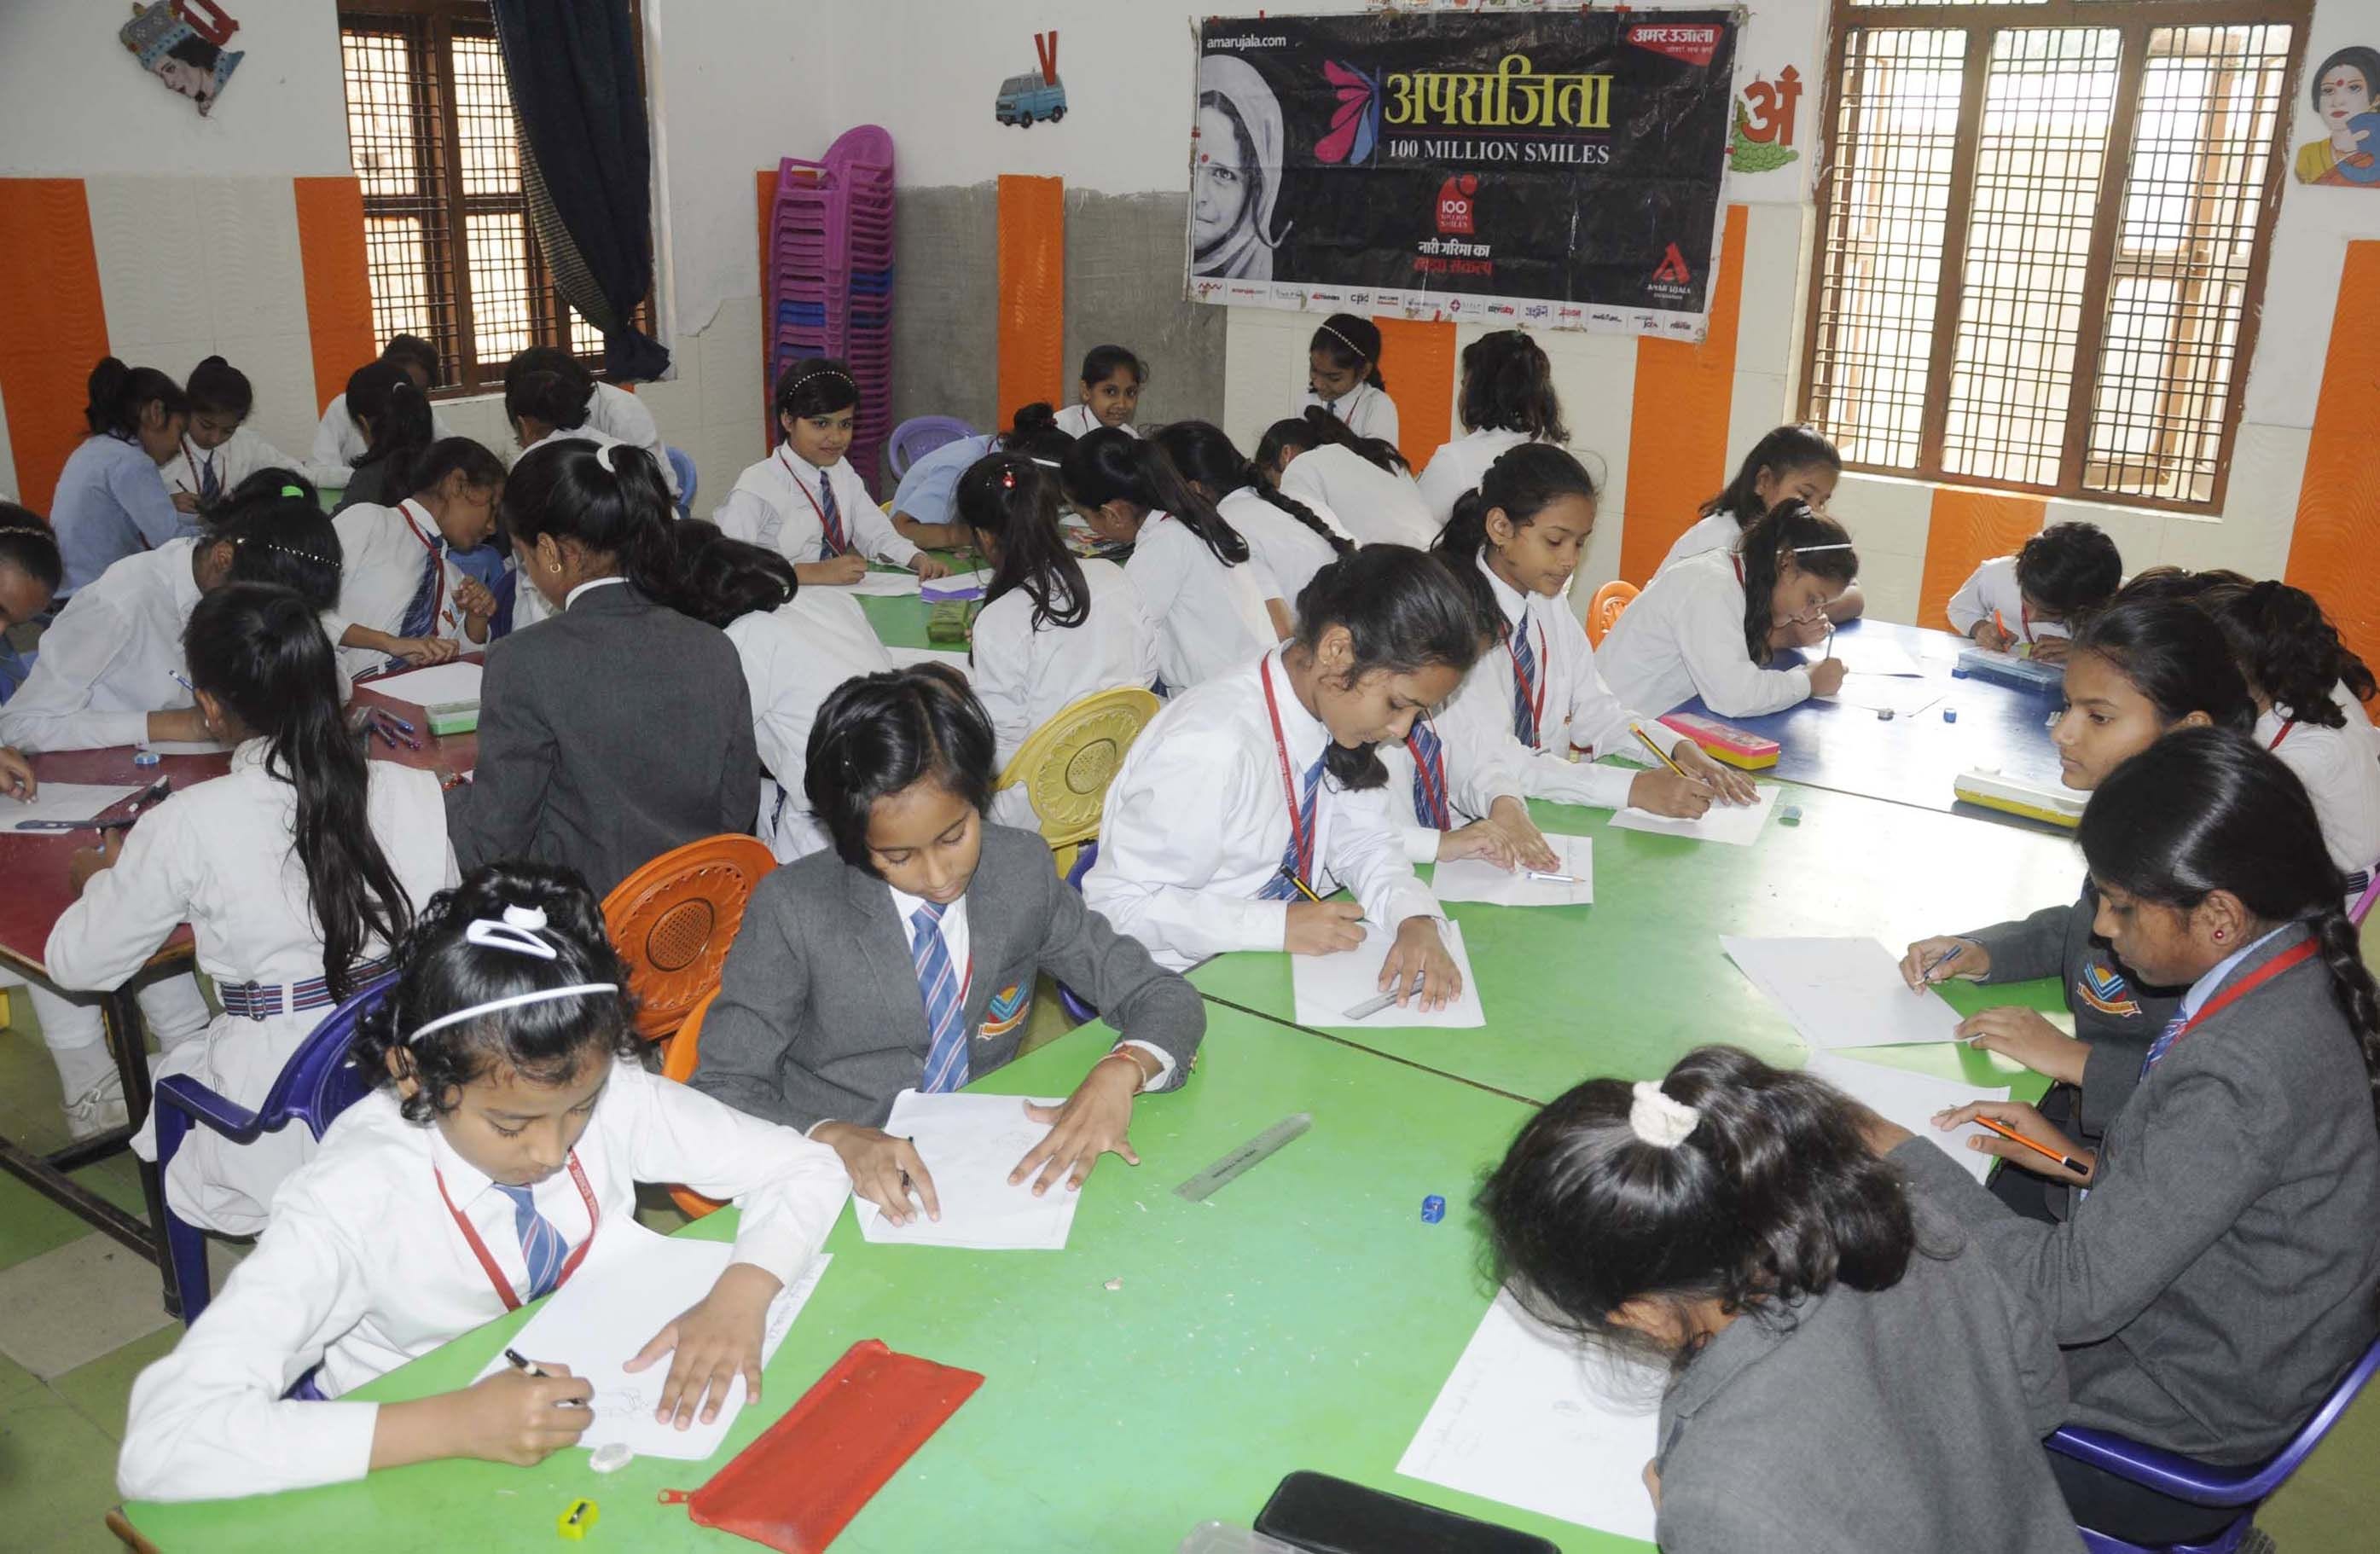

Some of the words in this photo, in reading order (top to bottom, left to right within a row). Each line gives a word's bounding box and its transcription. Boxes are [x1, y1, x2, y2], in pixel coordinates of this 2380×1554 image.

[1206, 34, 1286, 51] amarujala.com
[1633, 28, 1668, 43] अमर
[1669, 28, 1715, 43] उजाला
[1034, 31, 1057, 87] V
[1384, 54, 1614, 128] अपराजिता
[1390, 139, 1419, 159] 100
[1424, 140, 1518, 161] MILLION
[1524, 142, 1611, 165] SMILES
[1442, 200, 1467, 214] 100
[1418, 237, 1440, 254] नारी
[1440, 238, 1472, 257] गरिमा
[1473, 244, 1491, 258] का
